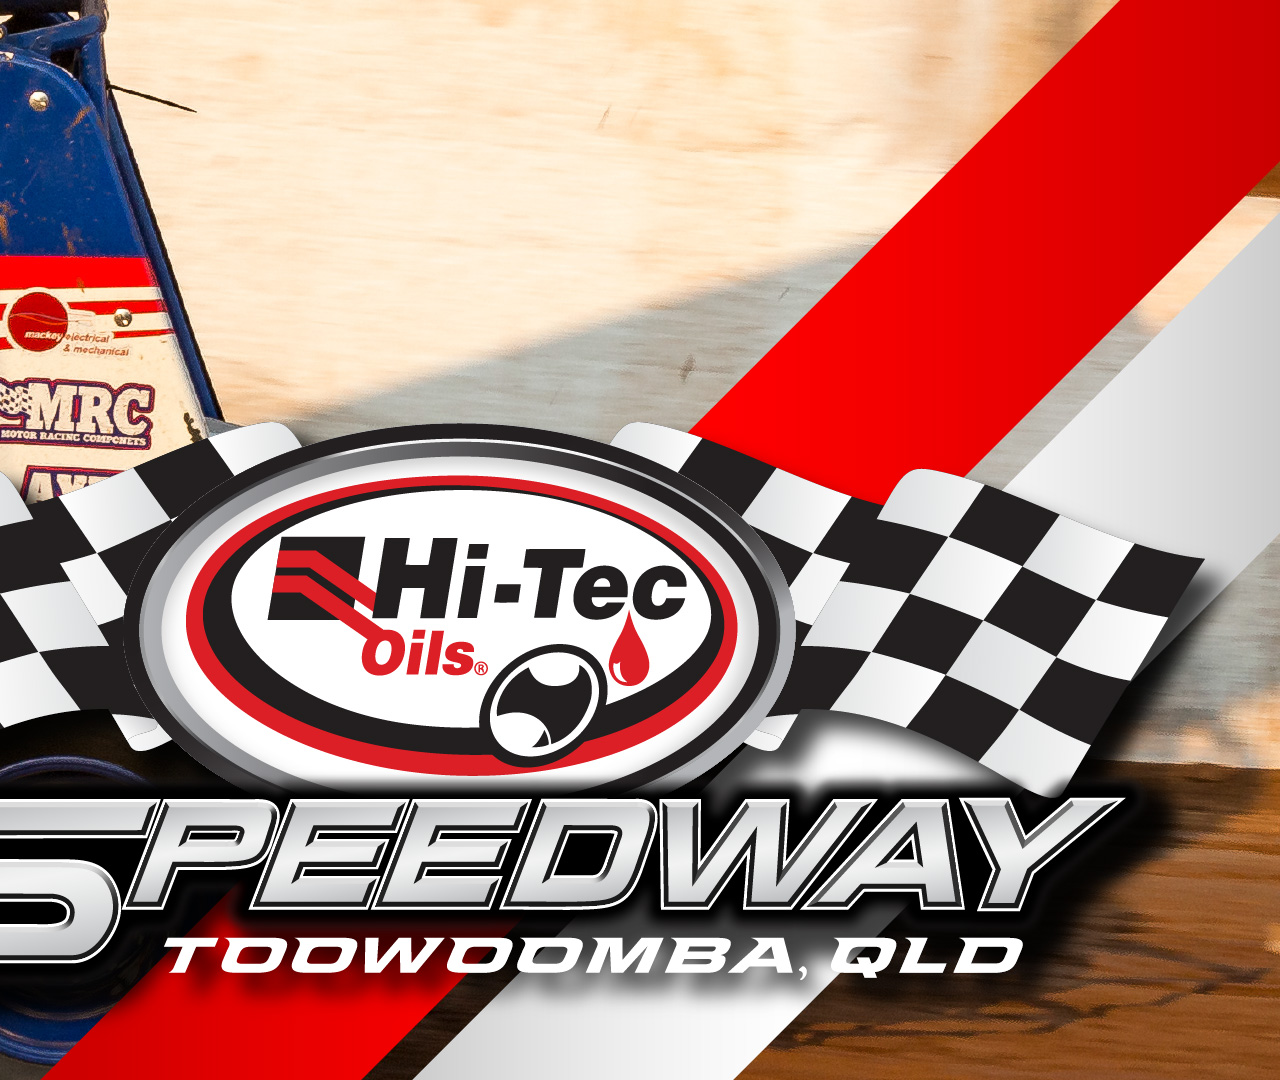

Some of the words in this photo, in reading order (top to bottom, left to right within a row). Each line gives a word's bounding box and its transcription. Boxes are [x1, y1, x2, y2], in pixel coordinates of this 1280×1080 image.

[65, 332, 110, 343] electrical
[73, 345, 129, 356] mechanical
[25, 382, 151, 437] MRC
[1, 430, 38, 440] MOTOR
[40, 432, 81, 442] RACING
